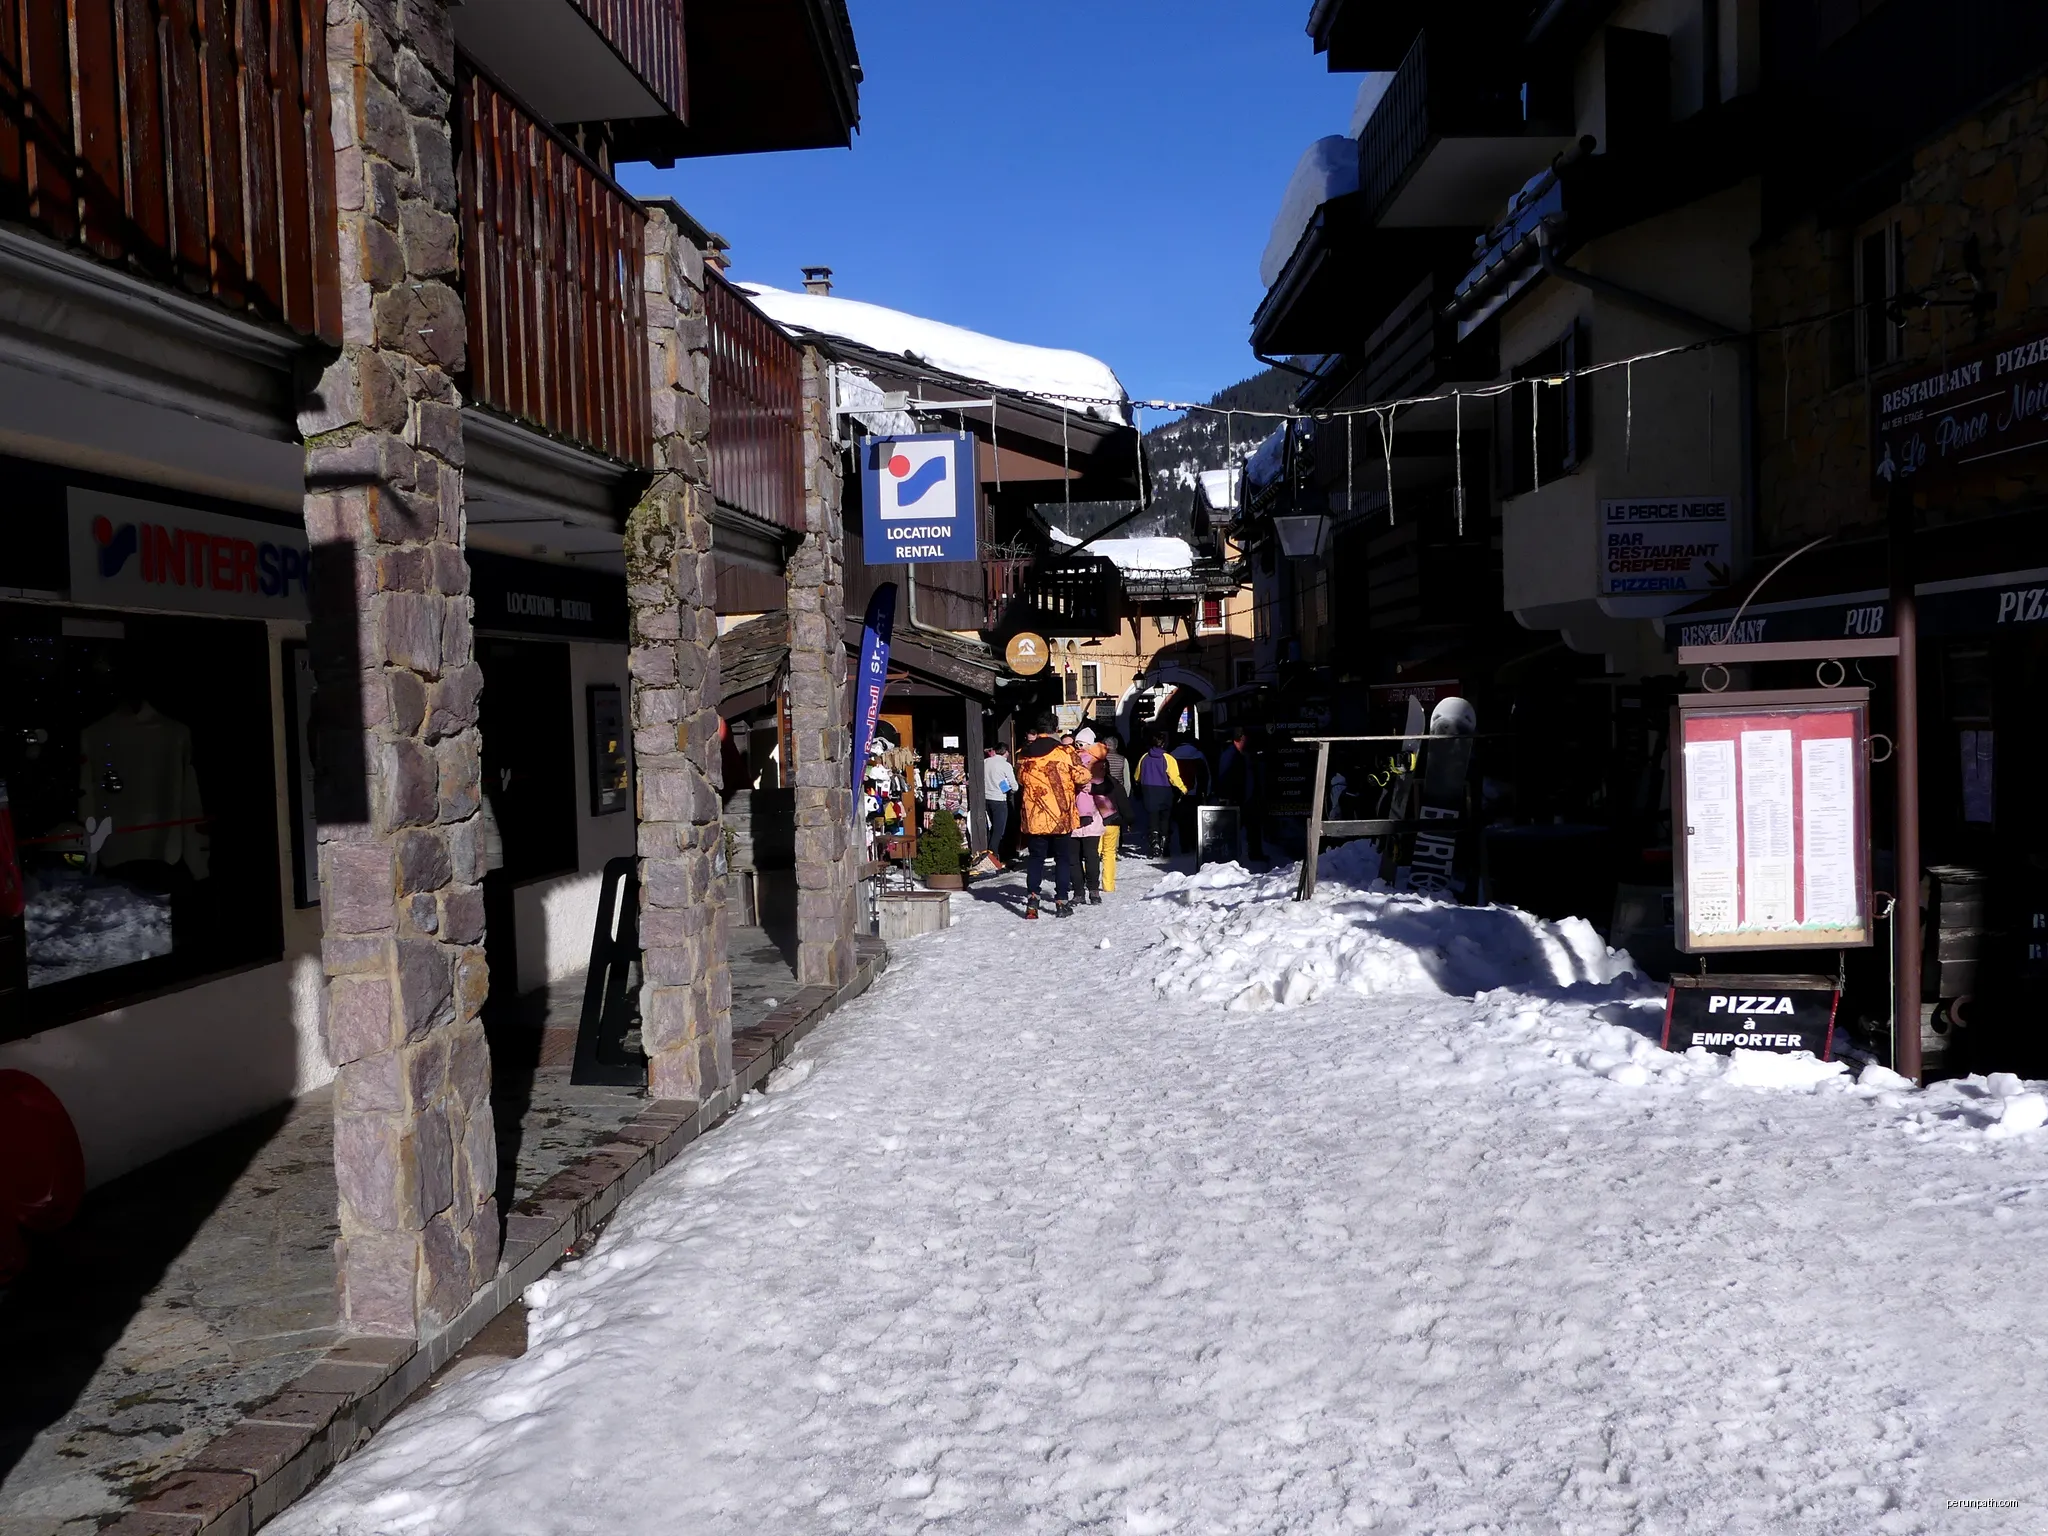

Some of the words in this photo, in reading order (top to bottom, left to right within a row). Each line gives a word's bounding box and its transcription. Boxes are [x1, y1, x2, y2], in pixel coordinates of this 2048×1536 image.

[1901, 432, 1926, 477] Le
[1935, 412, 1988, 457] Perce
[1607, 505, 1625, 520] LE
[1628, 504, 1678, 519] PERCE
[1682, 502, 1726, 518] NEIGE
[886, 525, 951, 540] LOCATION
[1607, 533, 1644, 546] BAR
[896, 544, 945, 559] RENTAL
[1607, 543, 1719, 559] RESTAURANT
[1608, 557, 1692, 573] CREPERIE
[1611, 576, 1687, 592] PIZZERIA
[506, 591, 556, 618] LOCATION
[1843, 605, 1885, 636] PUB
[868, 684, 881, 720] Bull
[1708, 996, 1795, 1015] PIZZA
[1743, 1017, 1756, 1031] à
[1691, 1032, 1802, 1047] EMPORTER
